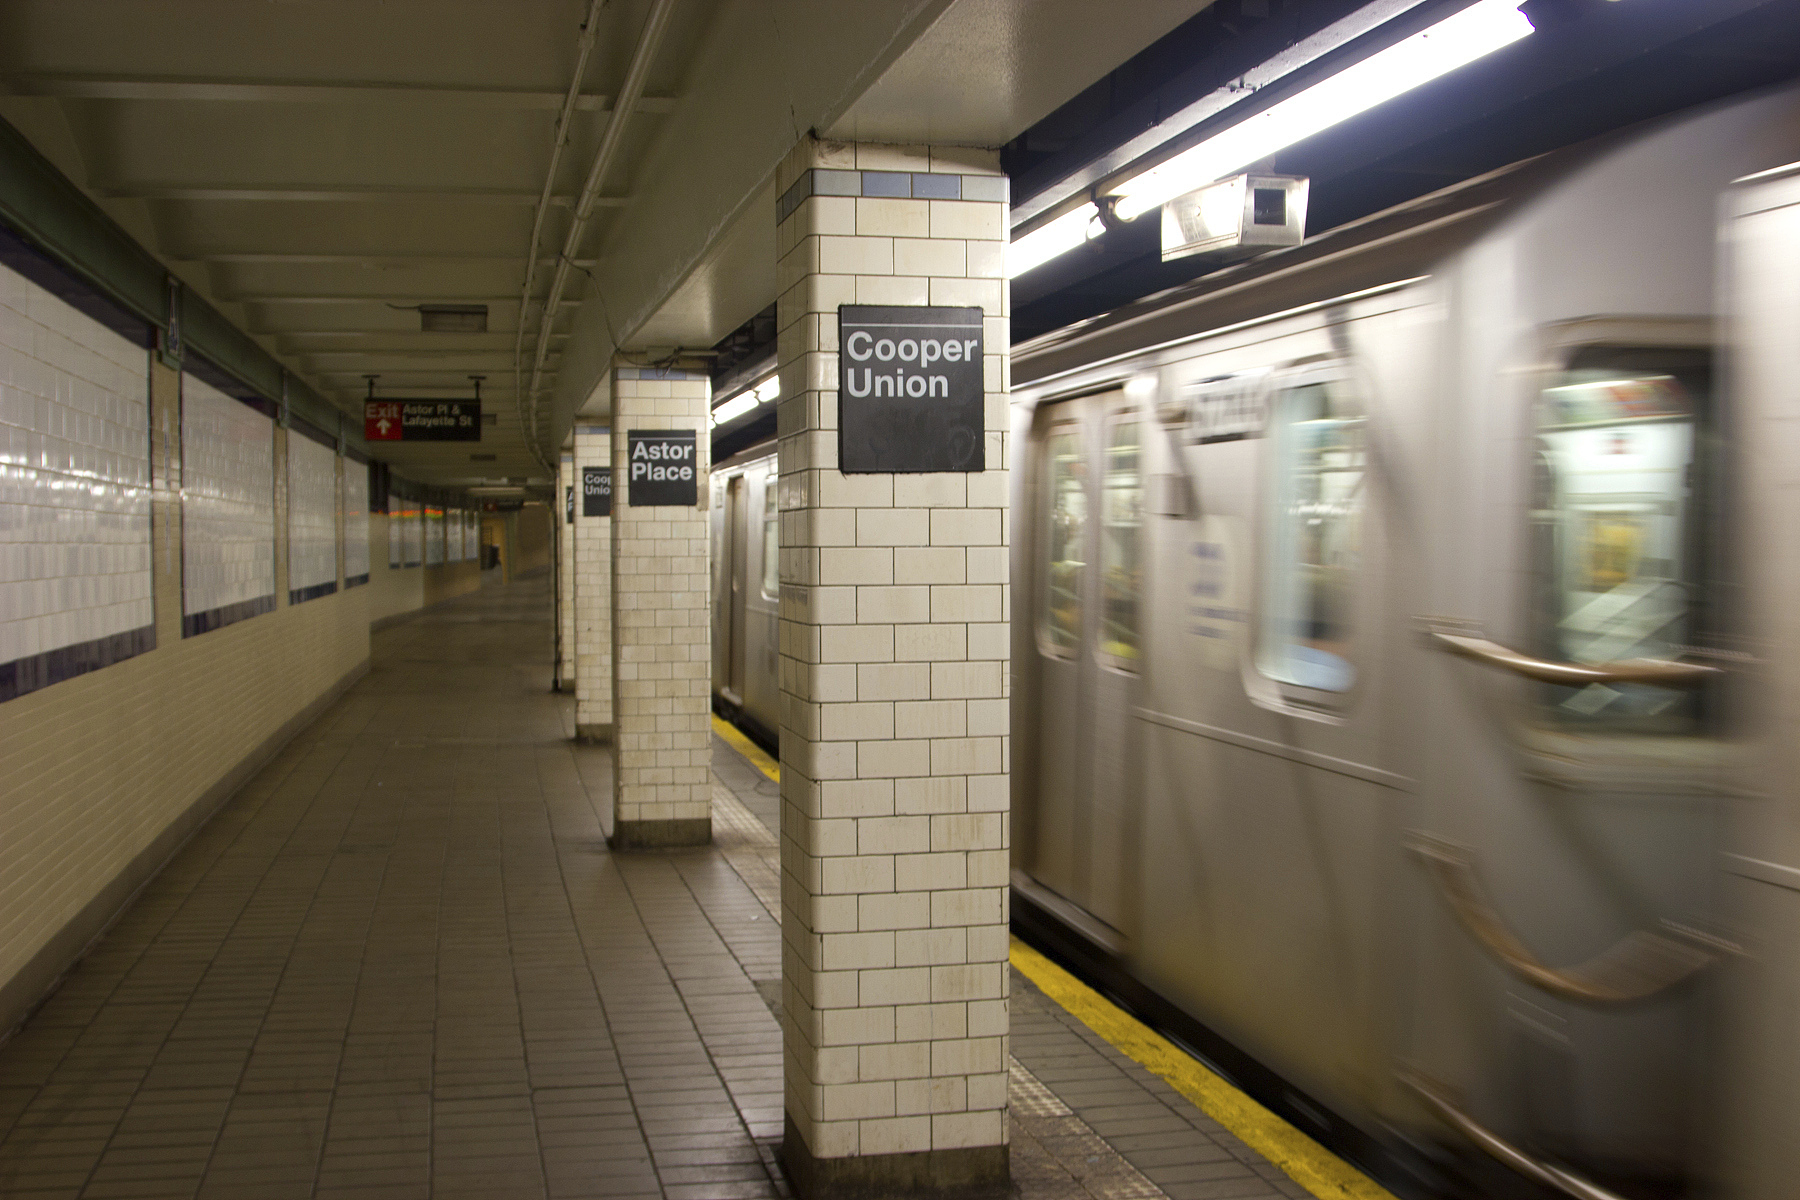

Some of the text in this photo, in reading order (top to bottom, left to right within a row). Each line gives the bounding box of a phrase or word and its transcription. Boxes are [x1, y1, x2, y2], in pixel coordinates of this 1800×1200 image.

[847, 330, 978, 368] Cooper
[847, 367, 949, 398] Union
[366, 403, 398, 418] Exit
[403, 403, 461, 415] Astor Pl &
[402, 415, 473, 428] Lafayette St
[632, 441, 693, 460] Astor
[631, 461, 693, 481] Place
